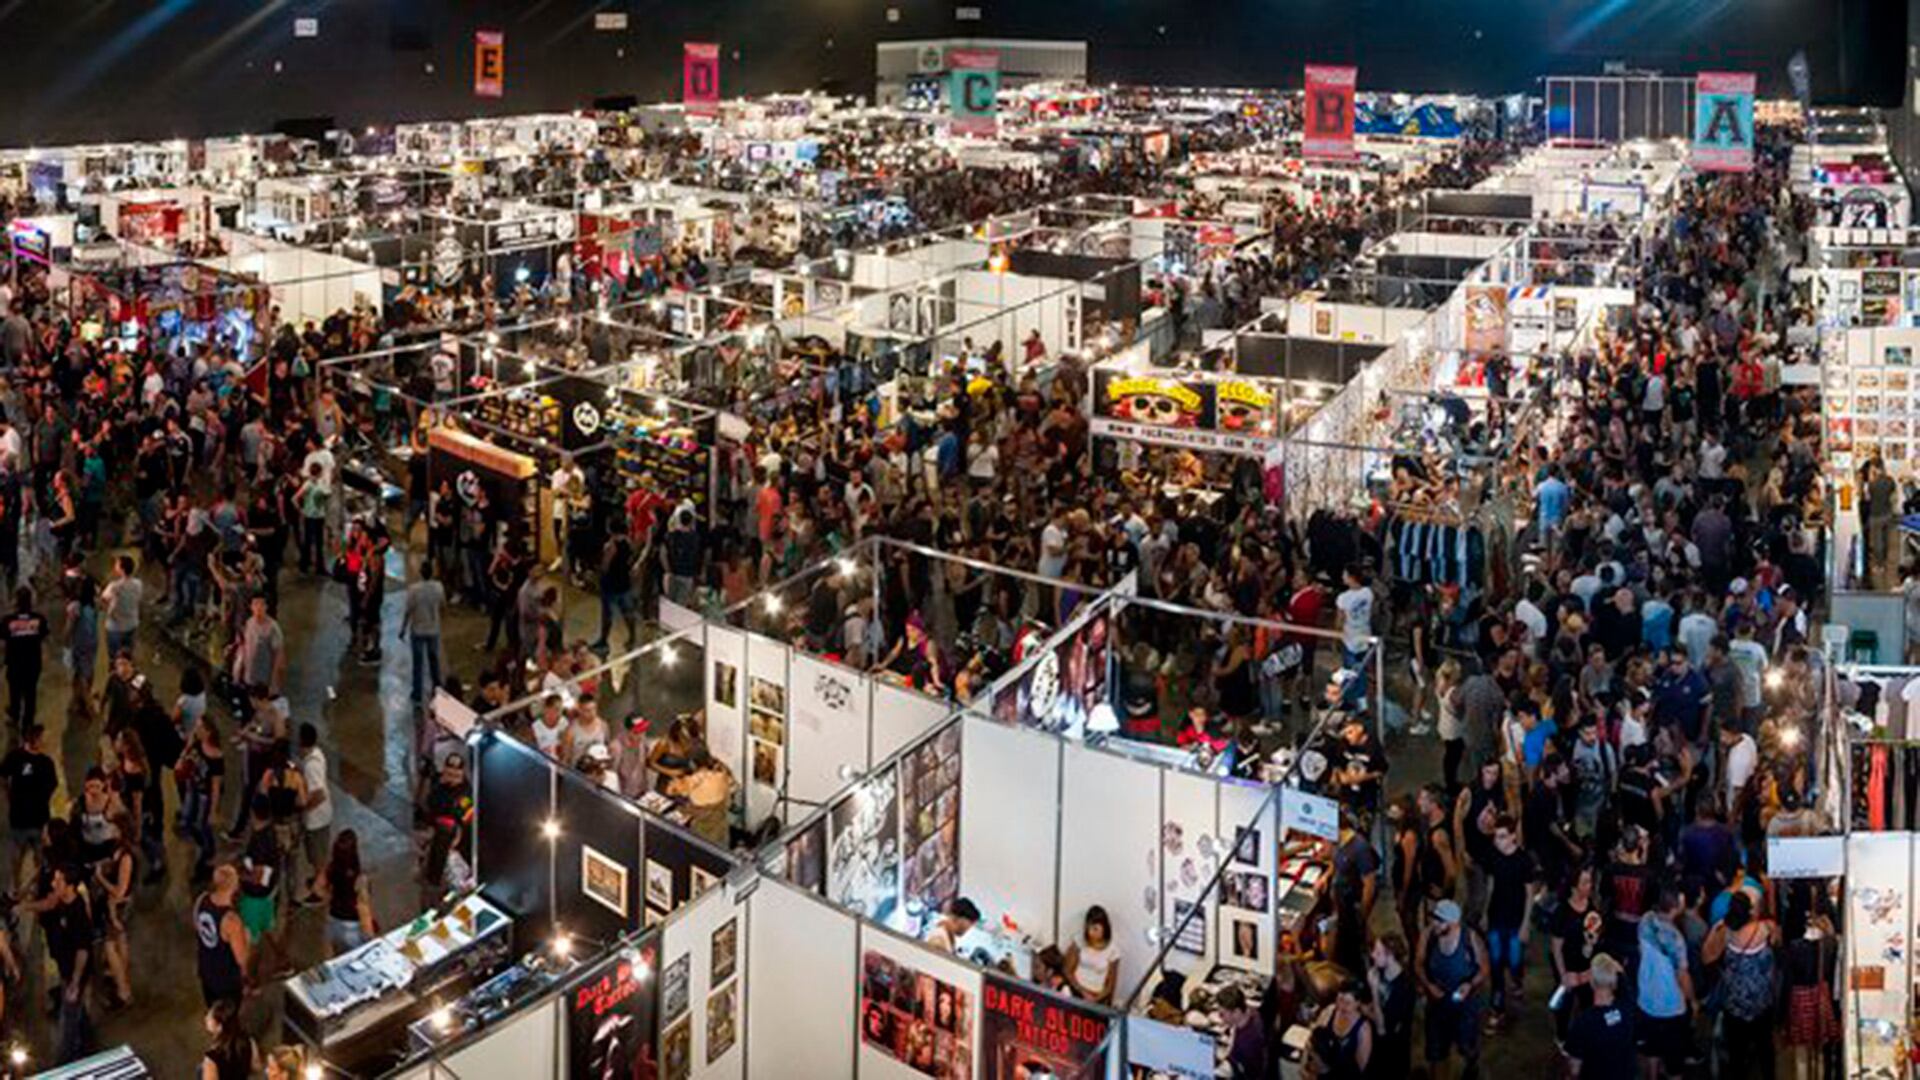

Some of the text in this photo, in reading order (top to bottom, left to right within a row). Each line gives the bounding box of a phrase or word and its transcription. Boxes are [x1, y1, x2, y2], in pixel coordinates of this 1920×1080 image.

[483, 48, 498, 78] E
[690, 62, 712, 97] D
[964, 73, 991, 112] C
[1315, 88, 1345, 133] B
[1706, 101, 1743, 142] A
[984, 984, 1035, 1024] DARK
